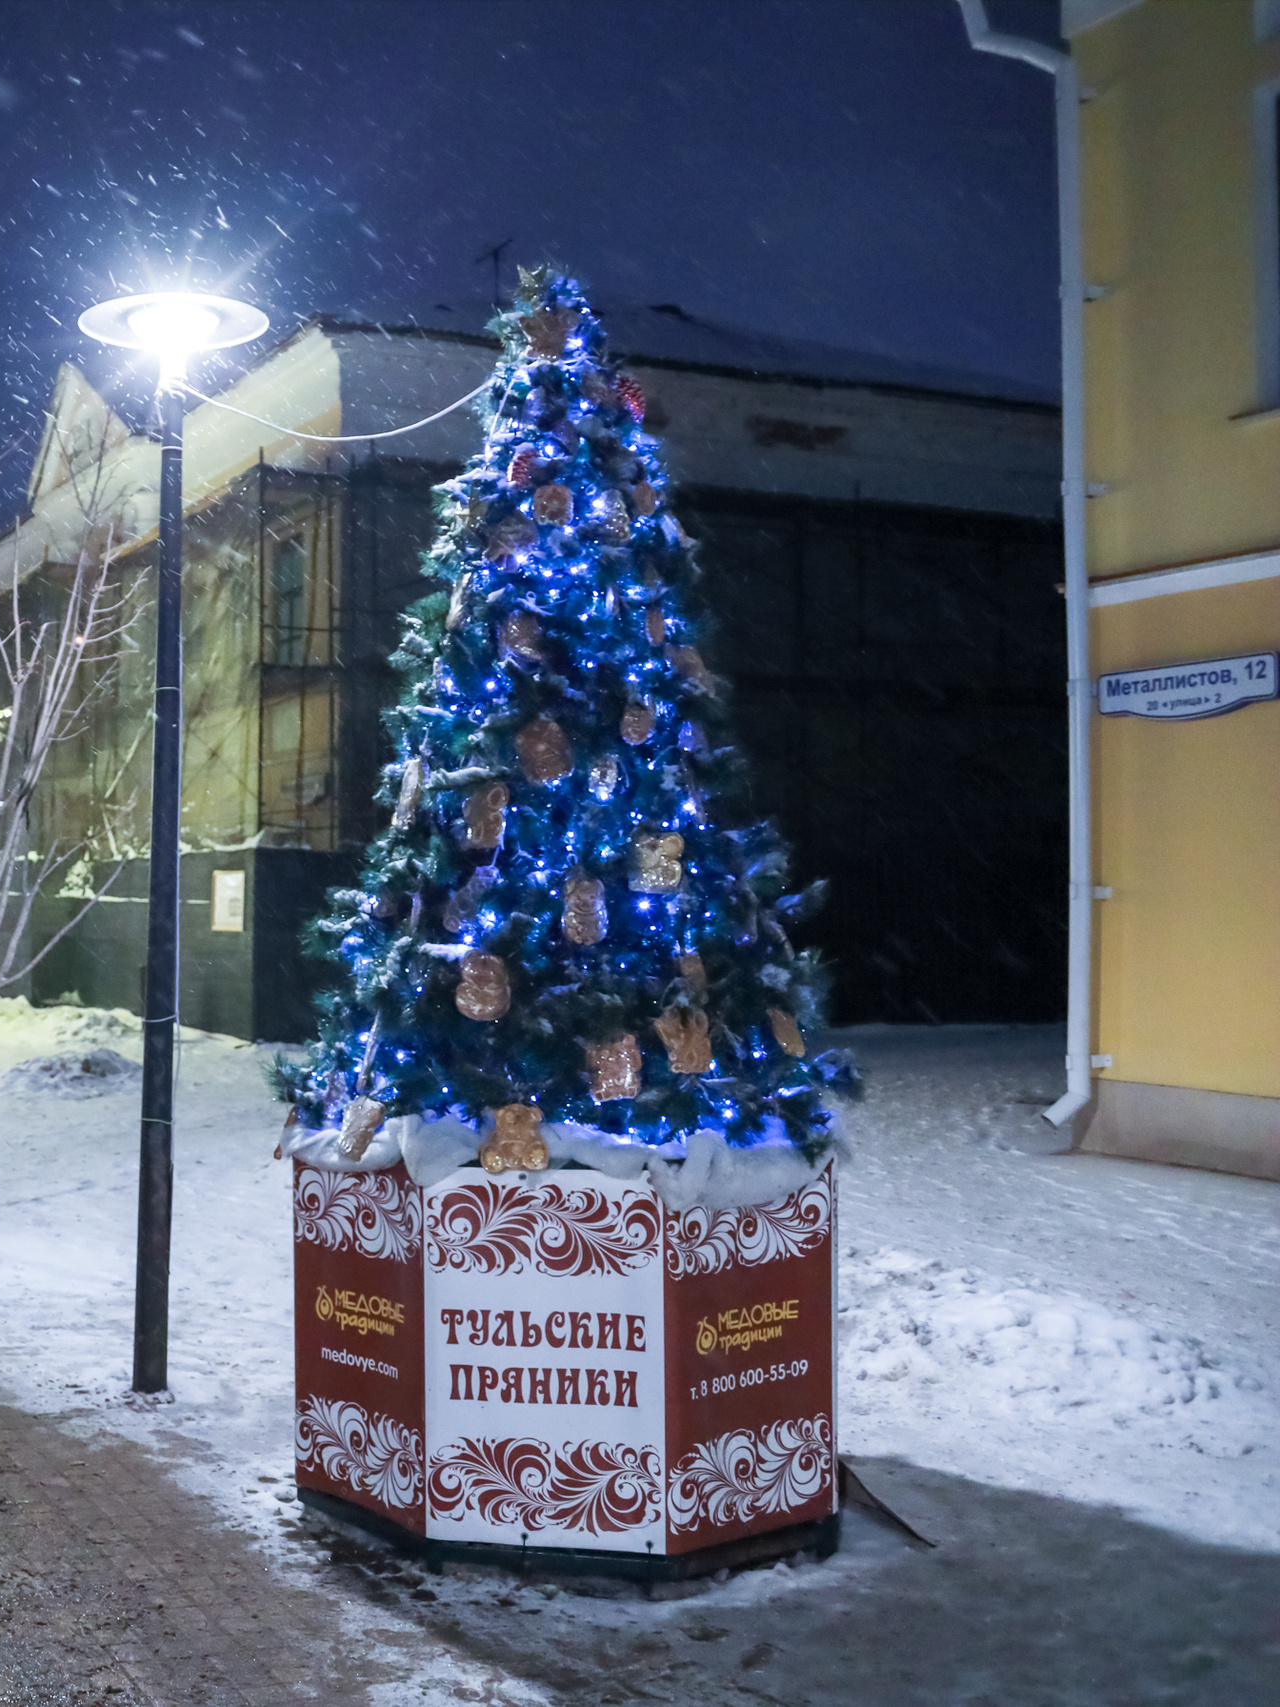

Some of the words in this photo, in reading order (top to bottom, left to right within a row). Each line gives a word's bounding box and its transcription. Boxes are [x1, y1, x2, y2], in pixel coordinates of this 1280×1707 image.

[1106, 669, 1238, 697] Металлистов,
[1245, 660, 1267, 680] 12
[1169, 697, 1202, 710] улица
[1214, 693, 1222, 704] 2
[334, 1288, 405, 1323] МЕДОВЫЕ
[717, 1299, 799, 1331] МЕДОВЫЕ
[334, 1310, 396, 1338] традиции
[441, 1309, 646, 1352] ТУЛЬСКИЕ
[718, 1325, 783, 1354] традиции
[320, 1346, 399, 1380] medovye.com
[700, 1379, 709, 1396] 8
[711, 1374, 736, 1395] 800
[740, 1360, 809, 1389] 600-55-09
[449, 1364, 638, 1408] ПРЯНИКИ
